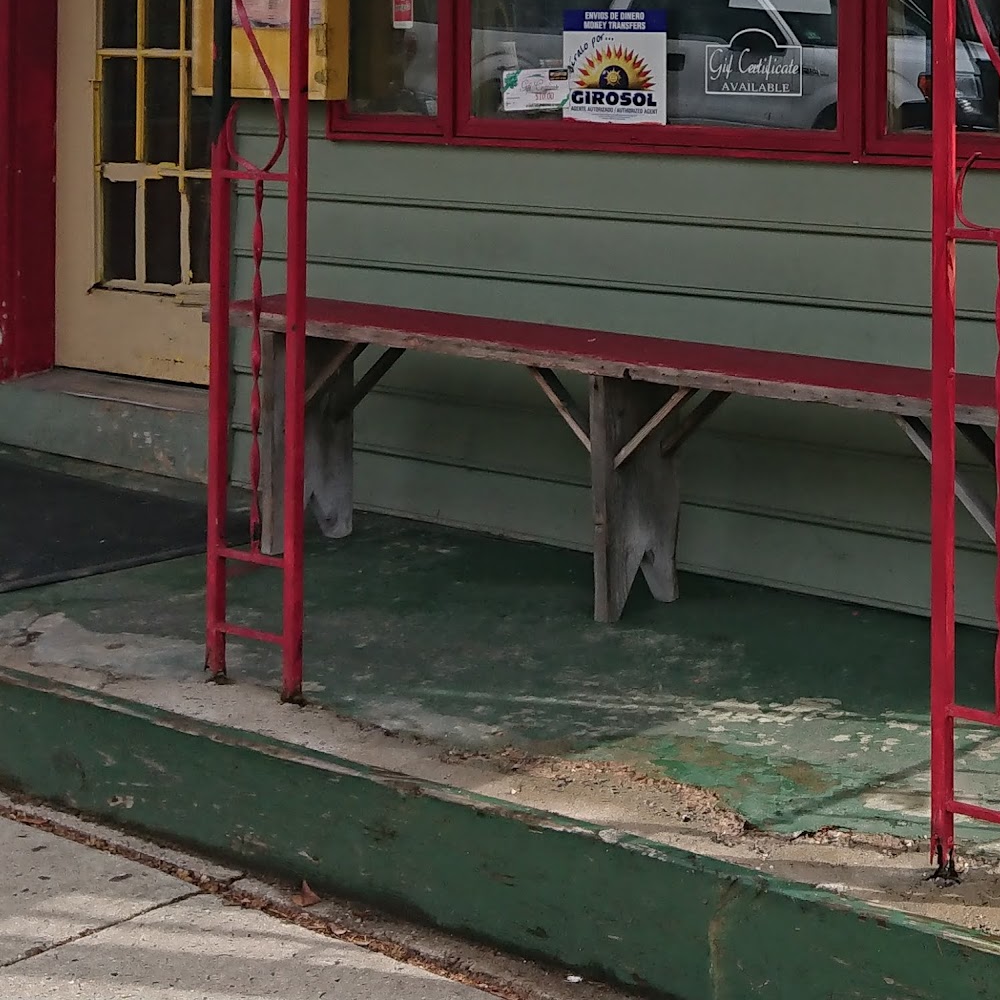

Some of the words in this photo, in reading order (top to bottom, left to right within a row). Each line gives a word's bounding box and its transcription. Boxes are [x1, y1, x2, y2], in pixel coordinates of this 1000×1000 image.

[584, 11, 609, 20] ENVIOS
[610, 11, 619, 20] DE
[620, 11, 645, 20] DINERO
[583, 21, 607, 30] MONEY
[608, 21, 646, 30] TRANSFERS
[738, 48, 800, 80] Certificate
[722, 82, 791, 92] AVAILABLE
[571, 90, 657, 107] GIROSOL
